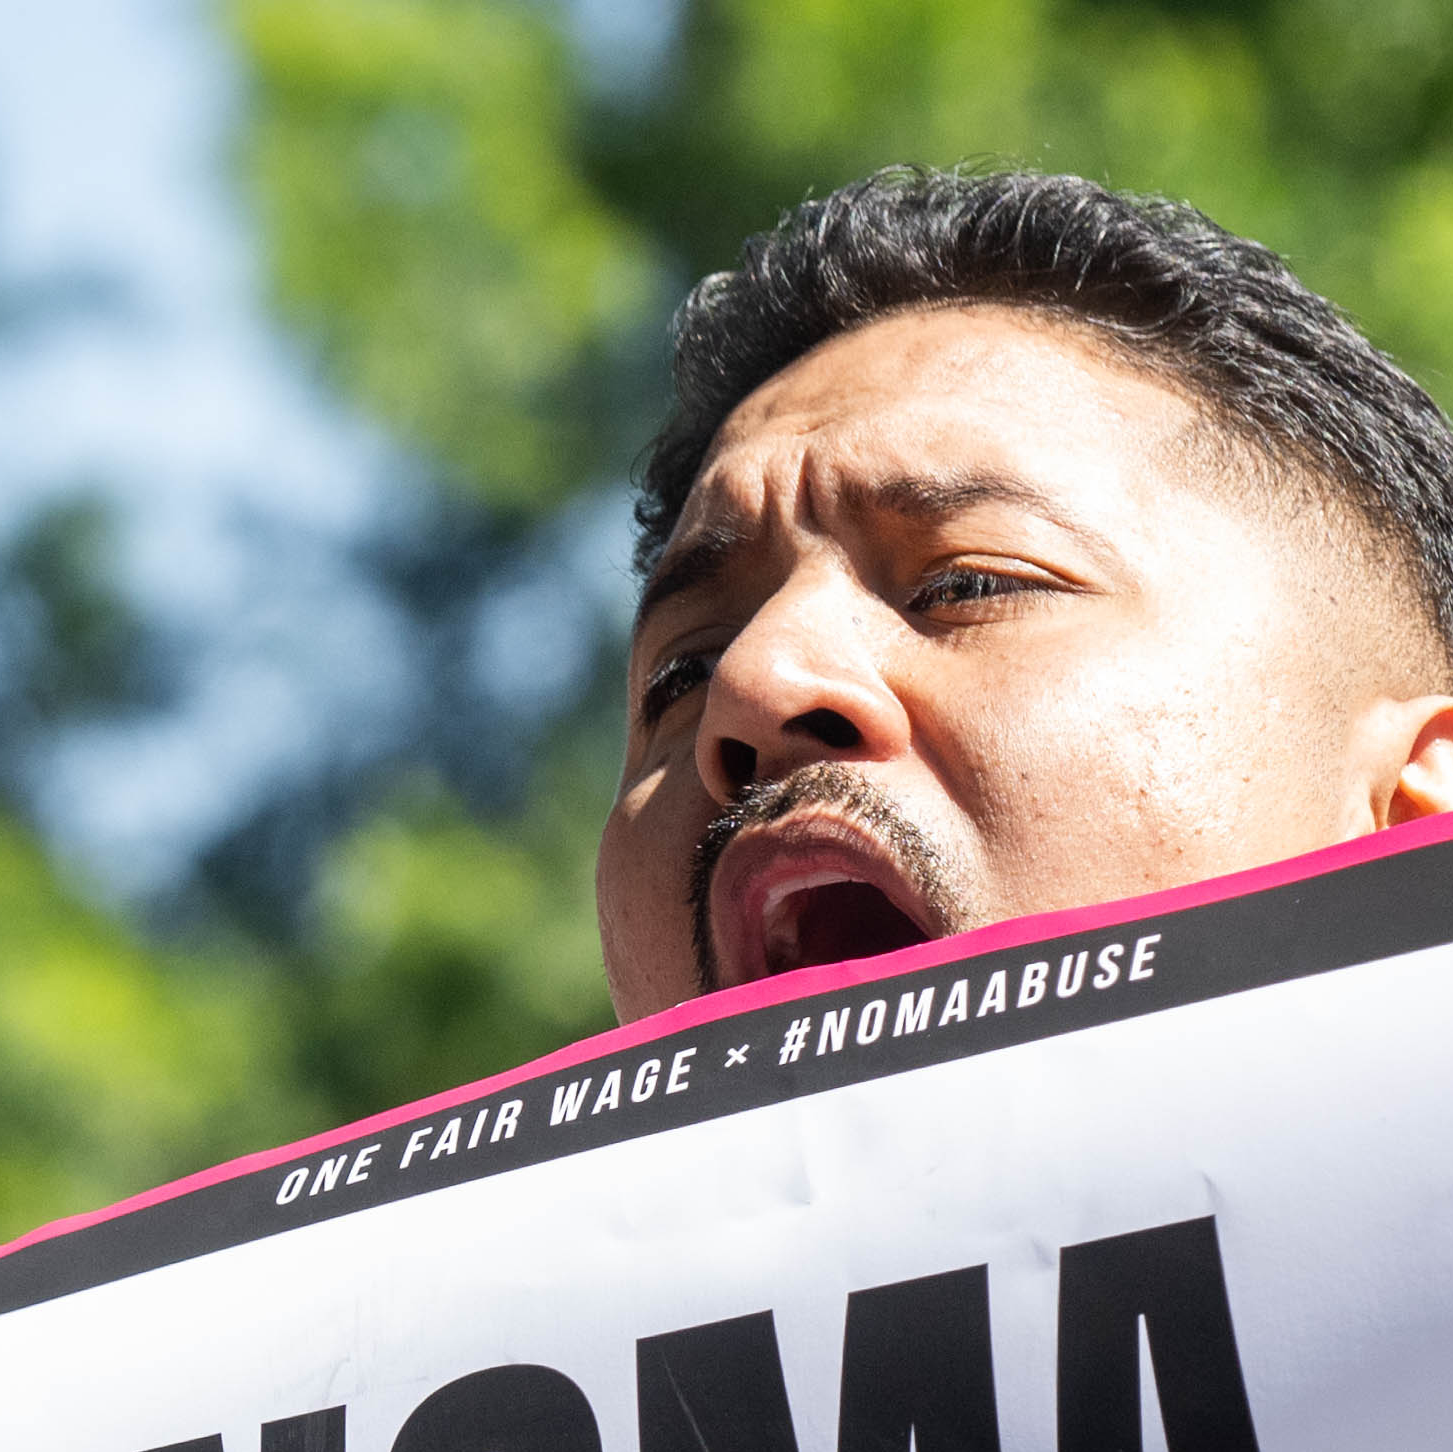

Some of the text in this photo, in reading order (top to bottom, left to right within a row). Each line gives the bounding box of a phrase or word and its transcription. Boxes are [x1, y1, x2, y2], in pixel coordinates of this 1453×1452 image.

[274, 1142, 383, 1207] ONE
[398, 1098, 525, 1171] FAIR
[548, 1045, 699, 1128] WAGE
[777, 932, 1163, 1067] #NOMAABUSE
